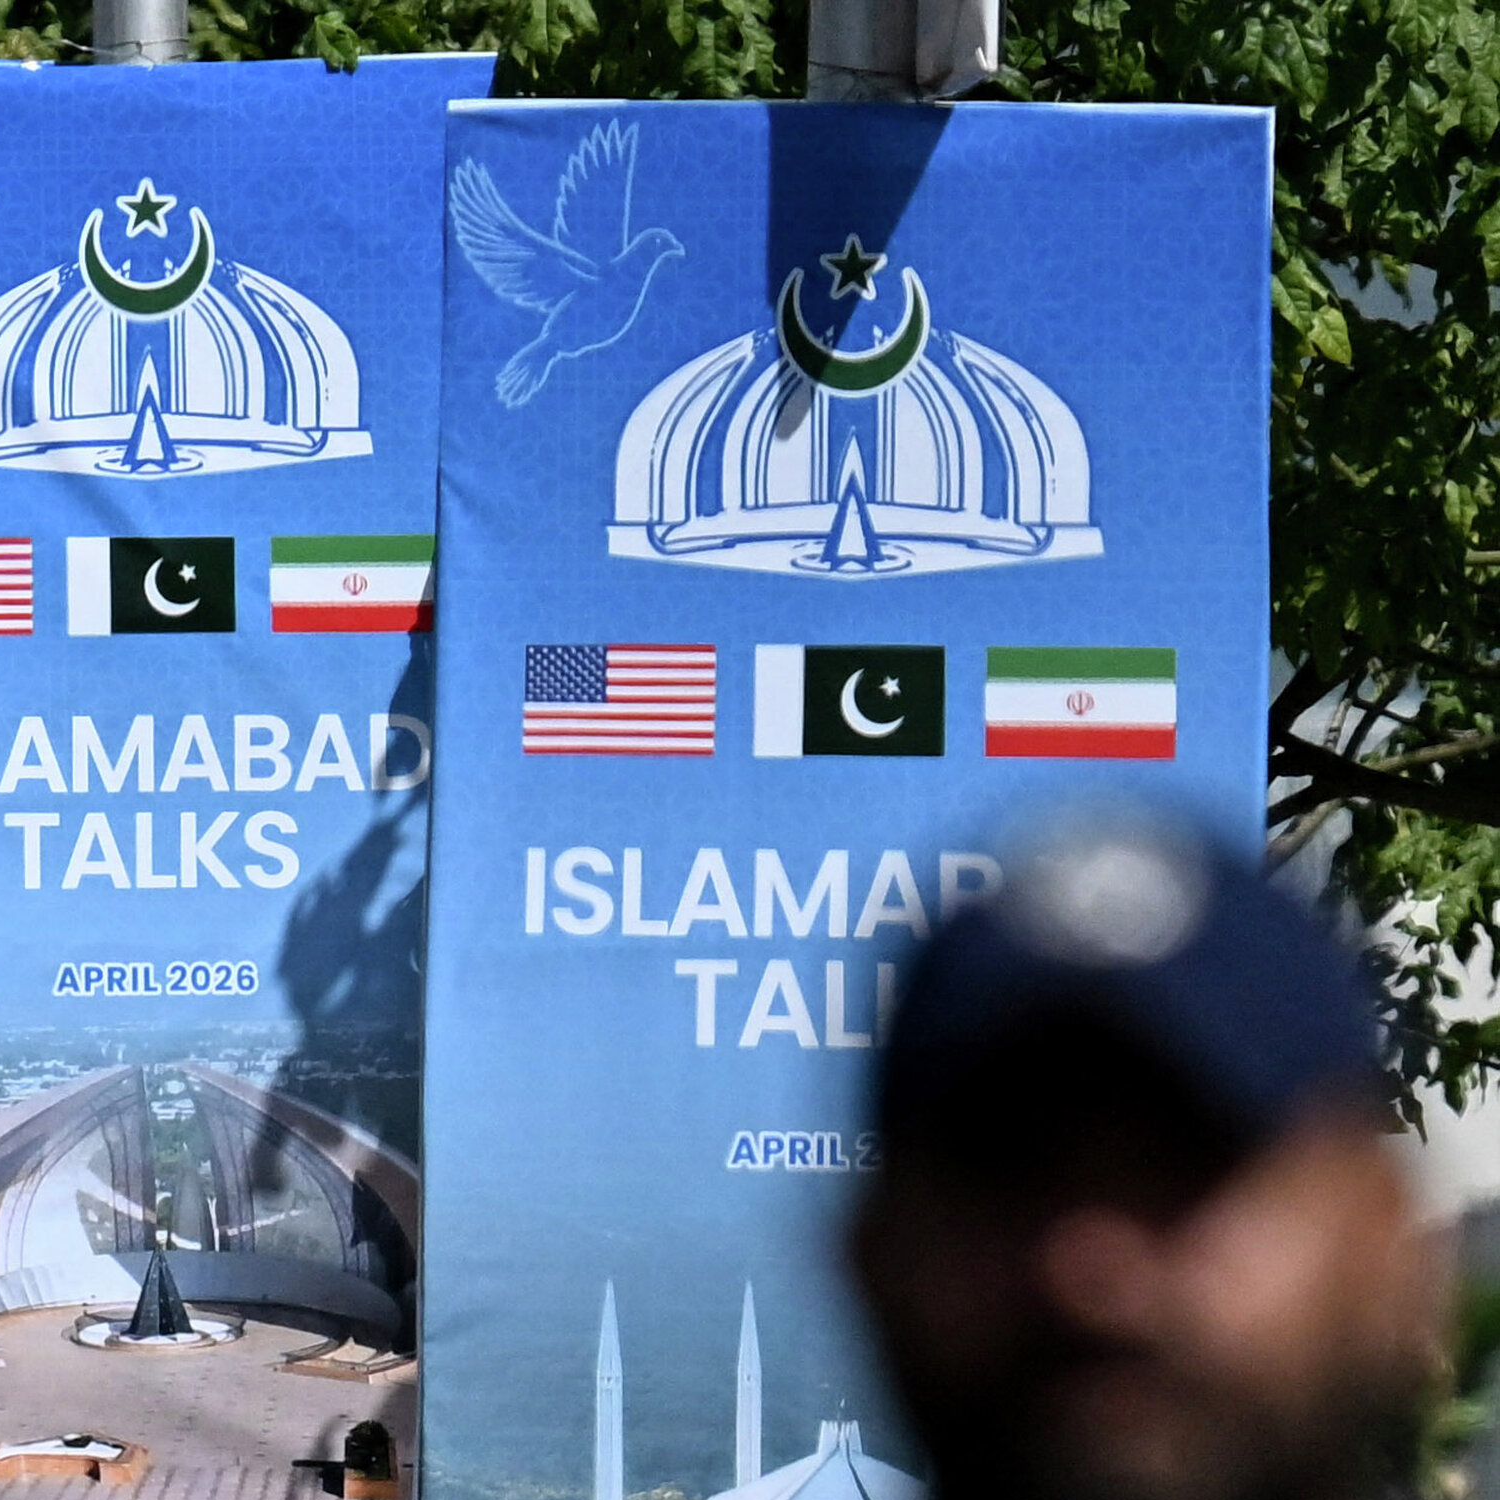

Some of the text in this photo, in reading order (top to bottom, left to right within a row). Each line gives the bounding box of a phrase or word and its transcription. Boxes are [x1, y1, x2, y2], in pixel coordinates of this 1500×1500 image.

[4, 810, 300, 890] TALKS
[525, 846, 1003, 938] ISLAMA
[53, 962, 257, 996] APRIL 2026
[675, 958, 897, 1048] TAL
[726, 1130, 850, 1172] APRIL
